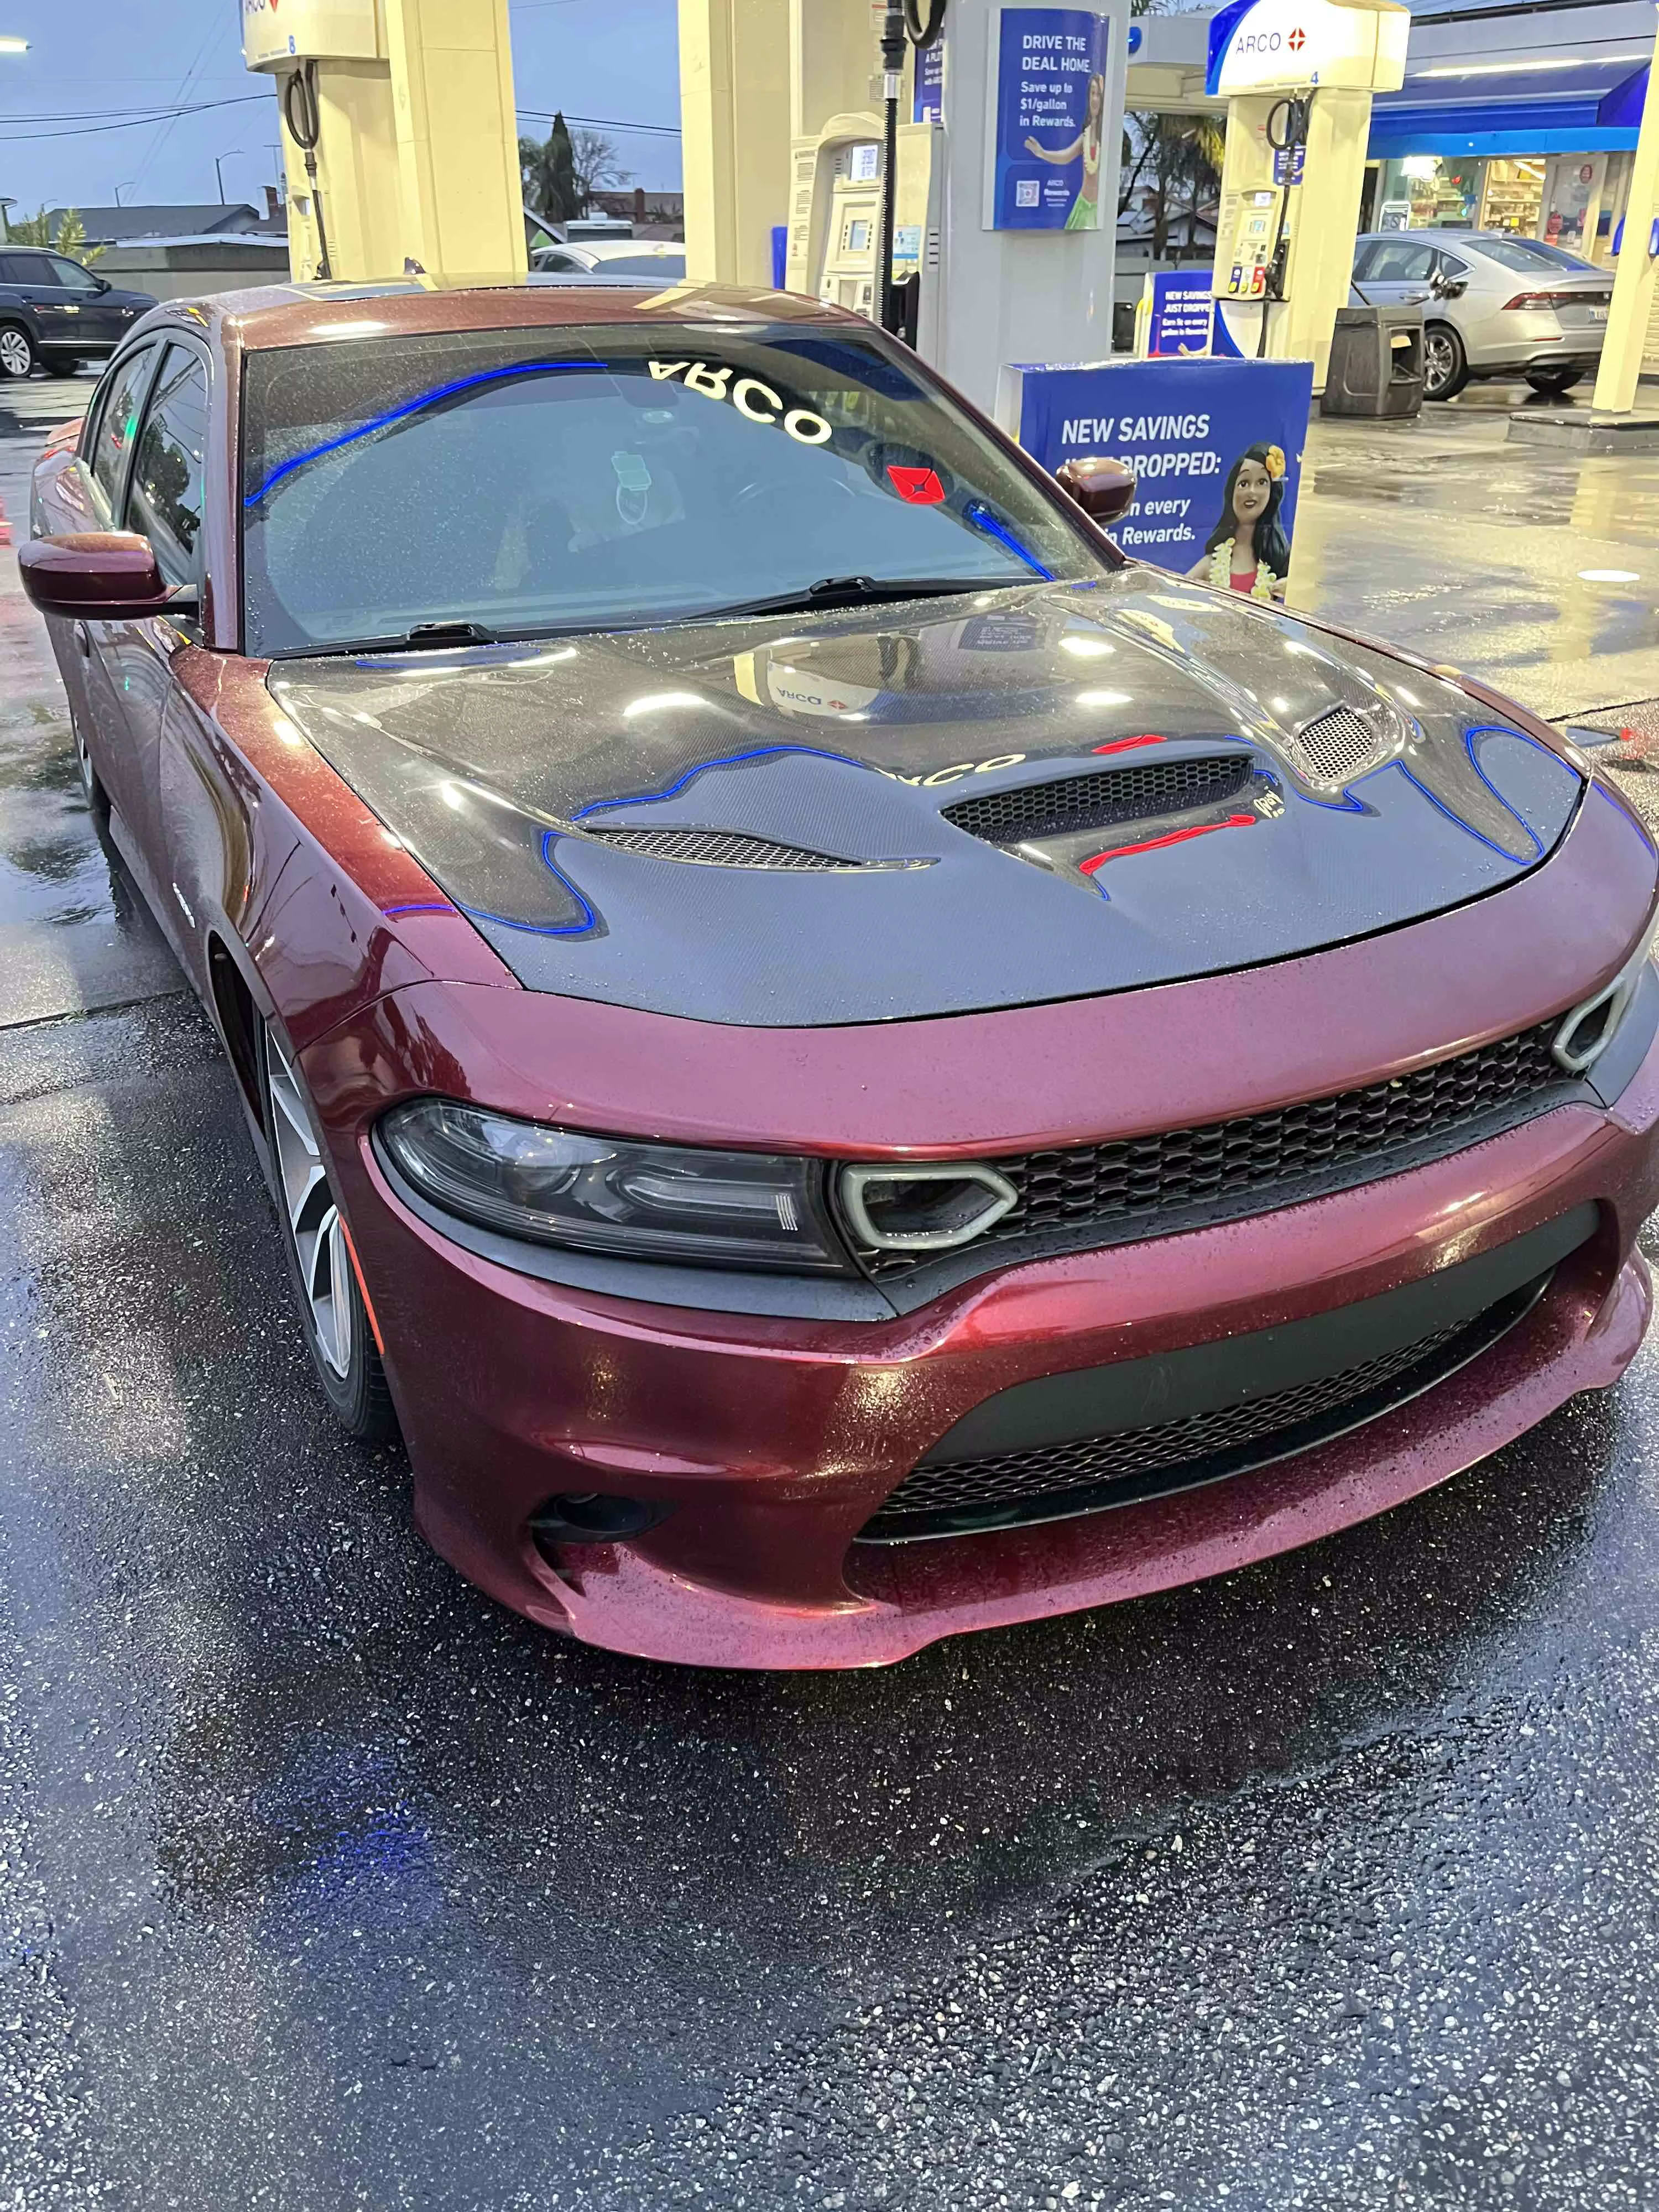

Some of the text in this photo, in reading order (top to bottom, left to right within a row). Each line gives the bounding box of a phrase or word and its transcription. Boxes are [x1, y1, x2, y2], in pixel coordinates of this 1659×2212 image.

[288, 35, 296, 54] 8
[1023, 35, 1086, 51] DRIVE THE
[1237, 33, 1281, 54] ARCO
[1022, 56, 1092, 72] DEAL HOME.
[1310, 71, 1319, 84] 4
[1021, 81, 1073, 95] Save up to
[1020, 98, 1067, 112] $1/gallon
[1020, 115, 1076, 127] in Rewards.
[1062, 414, 1210, 444] NEW SAVINGS
[1129, 499, 1191, 517] n every
[1122, 523, 1195, 545] Rewards.
